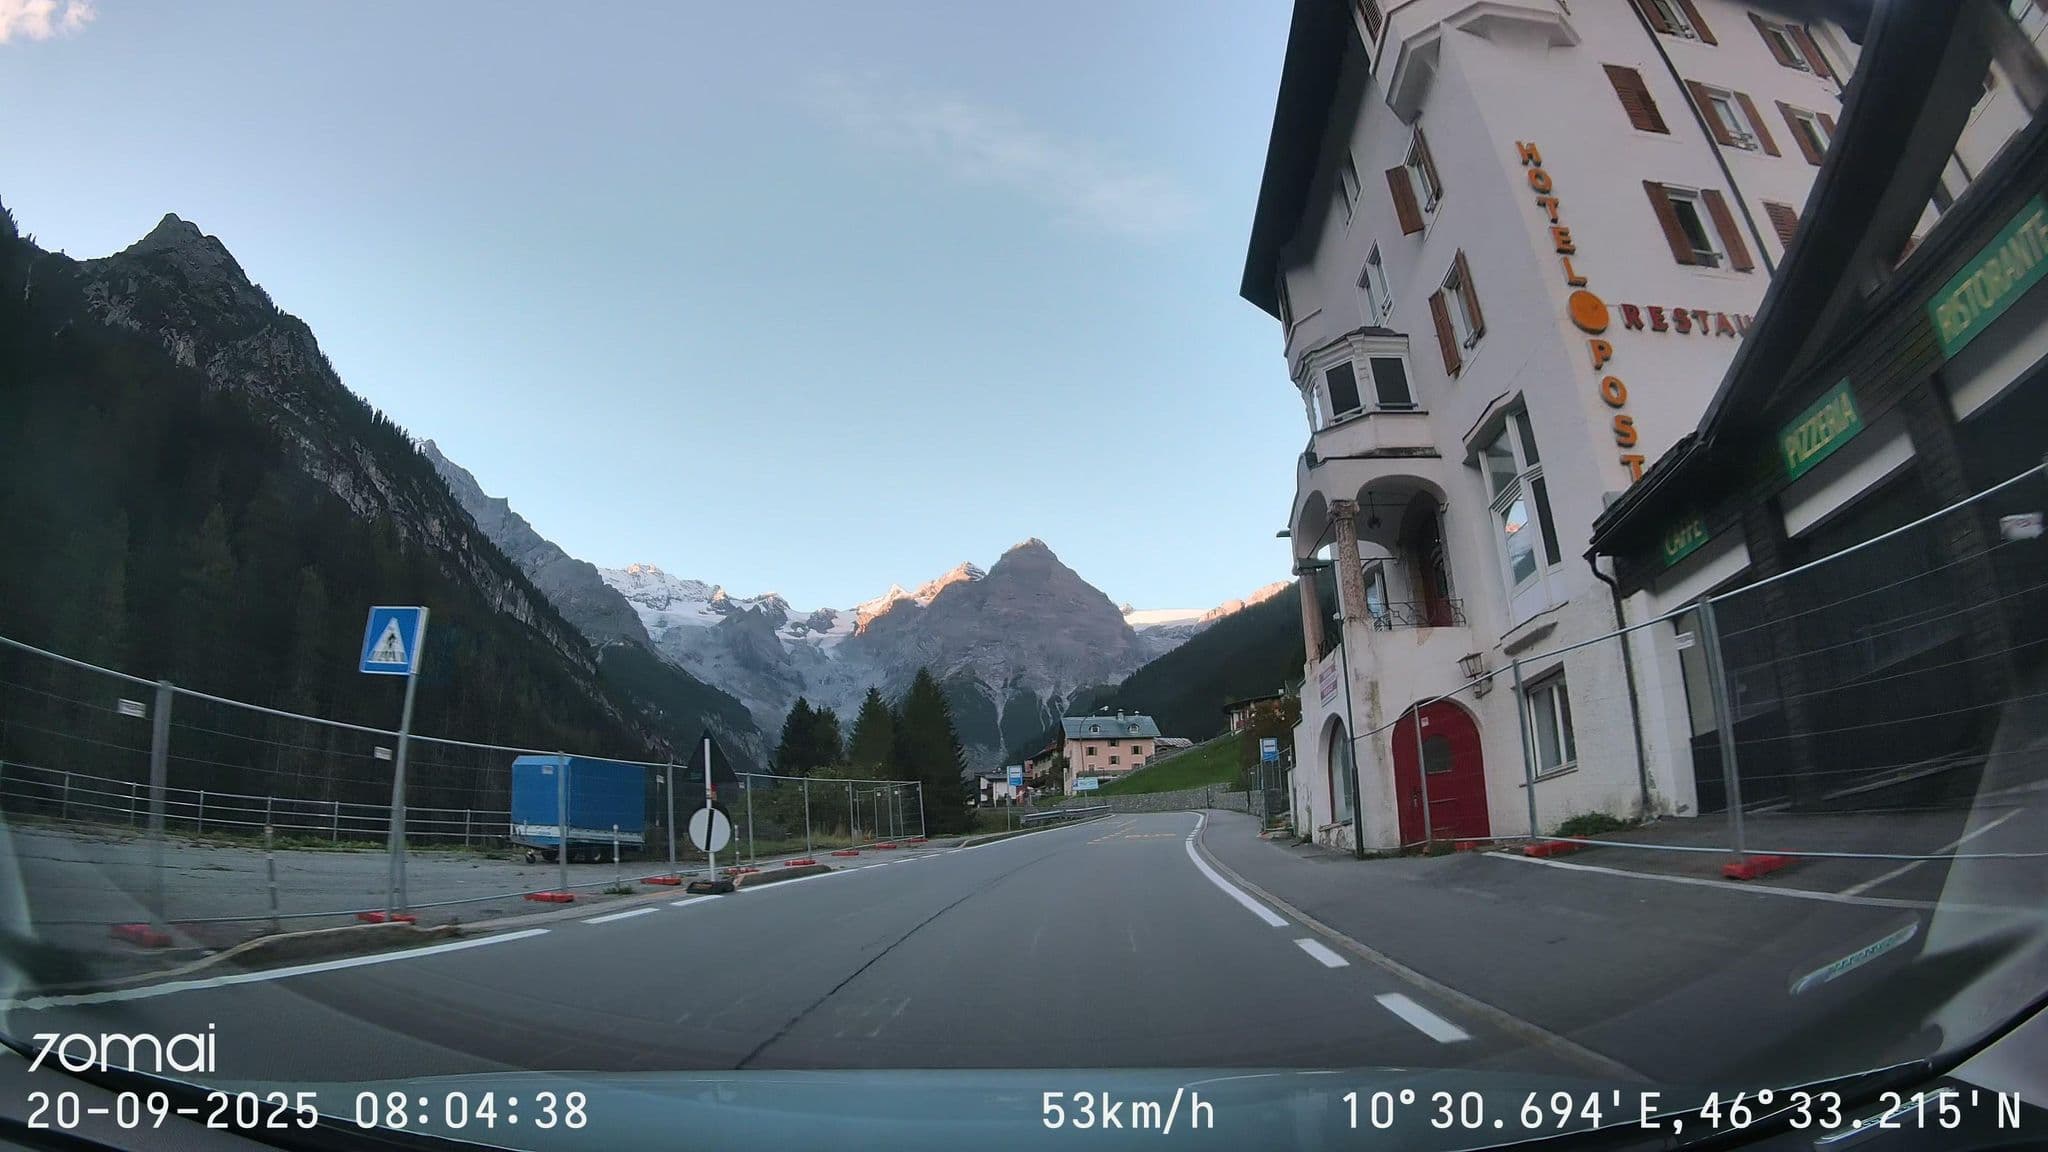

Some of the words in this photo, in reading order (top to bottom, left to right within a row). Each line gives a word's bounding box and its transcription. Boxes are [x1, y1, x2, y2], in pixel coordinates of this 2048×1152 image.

[1515, 141, 1588, 288] HOTEL
[1587, 339, 1645, 483] POST
[1785, 391, 1858, 469] PIZZERIA
